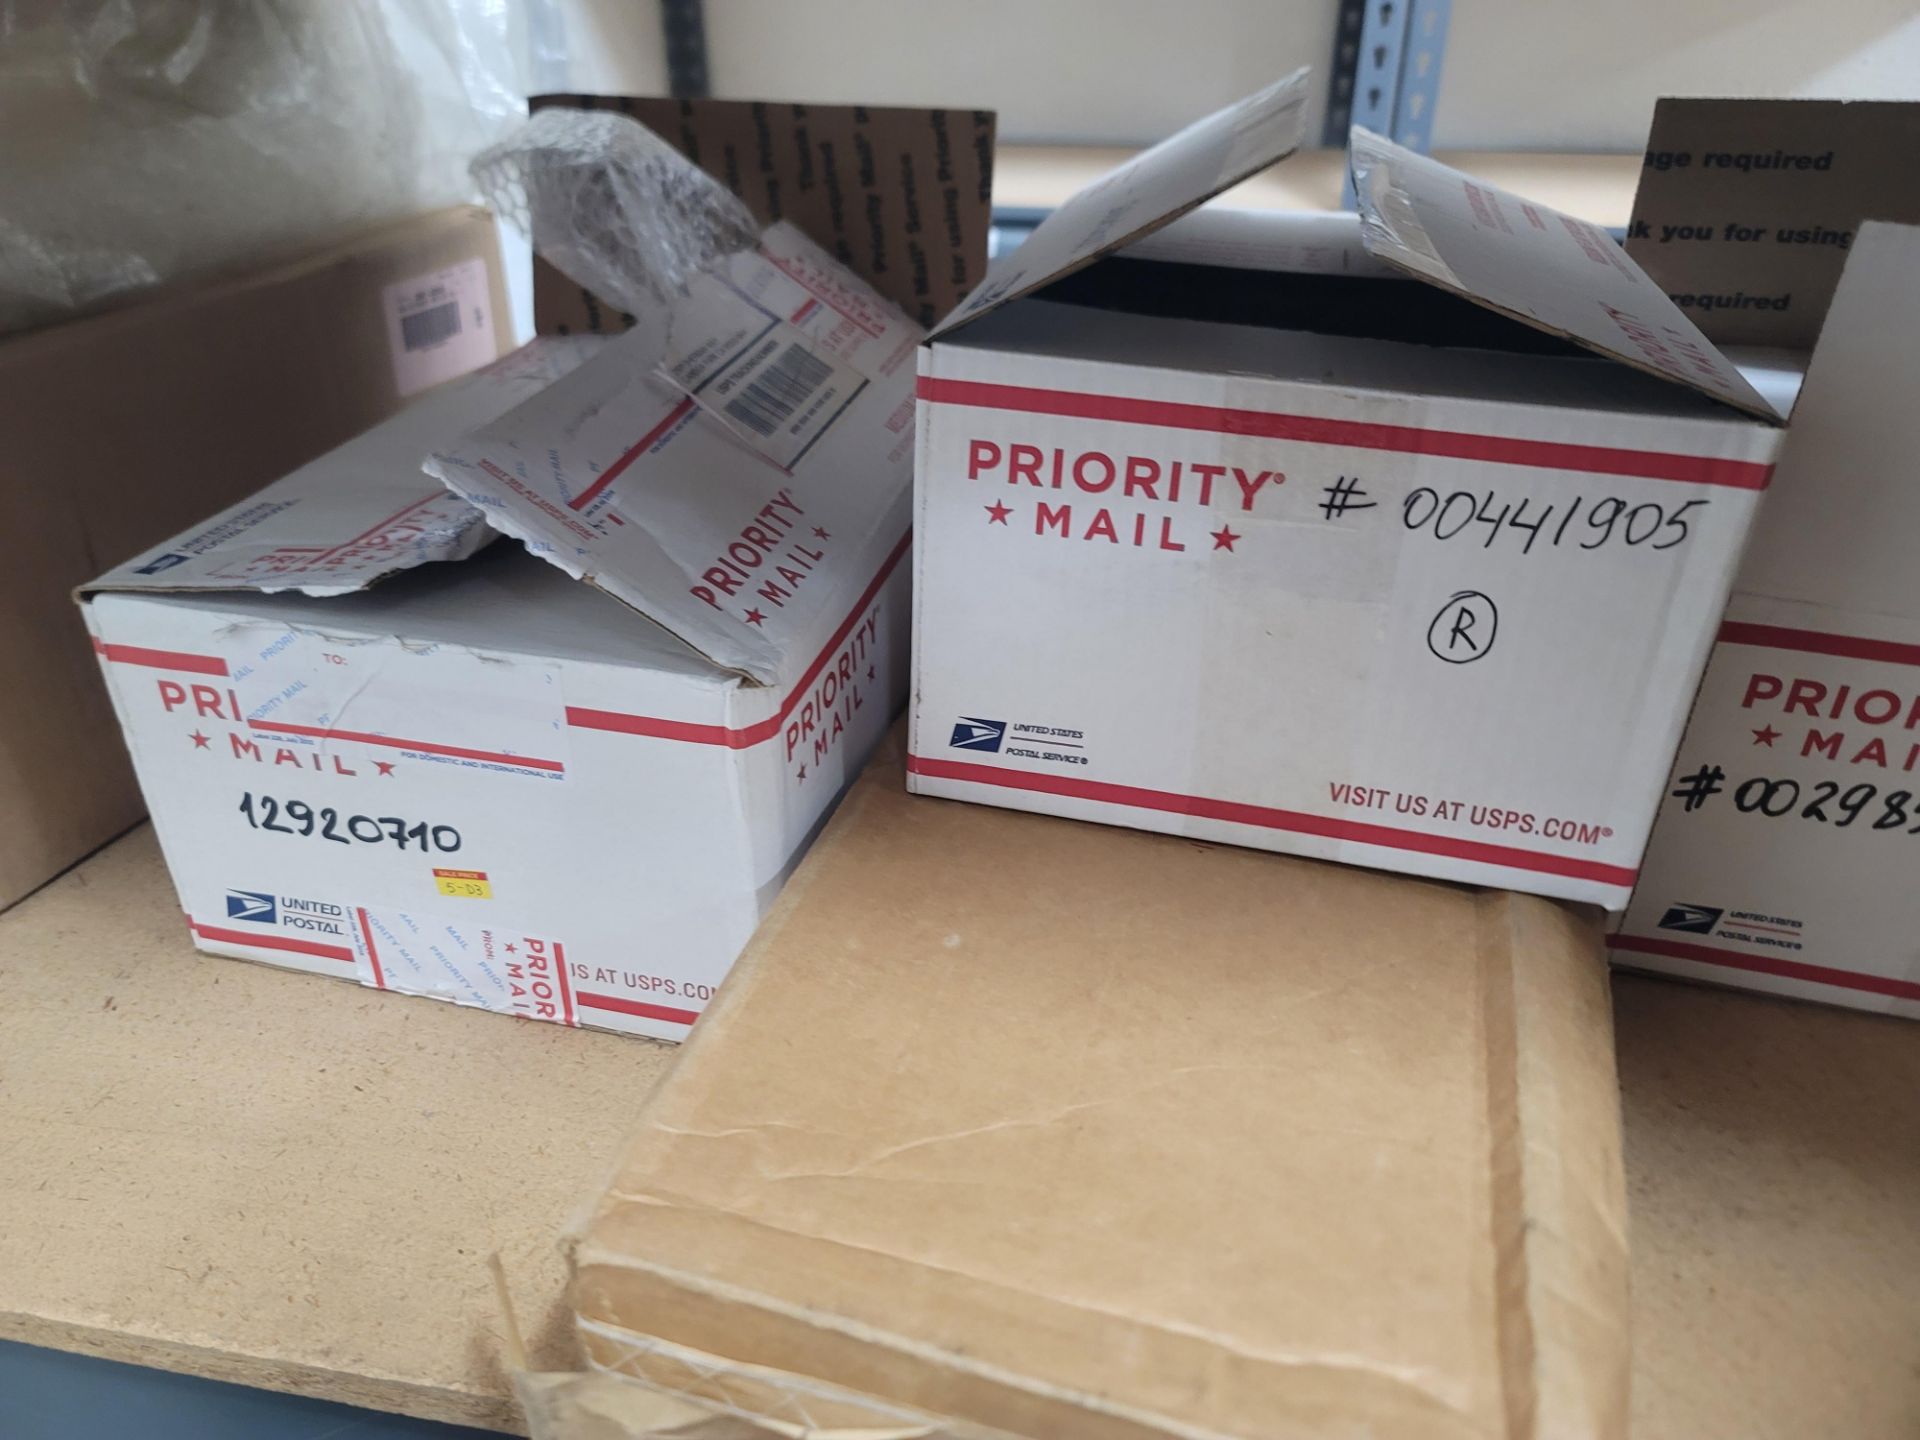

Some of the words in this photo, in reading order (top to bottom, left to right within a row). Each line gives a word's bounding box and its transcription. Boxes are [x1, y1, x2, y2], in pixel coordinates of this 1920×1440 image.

[930, 110, 953, 181] Priorit
[1704, 149, 1834, 173] required
[1660, 223, 1714, 243] you
[1724, 223, 1766, 242] for
[1776, 225, 1852, 249] using
[1035, 502, 1186, 552] MAIL
[1318, 475, 1377, 521] #
[1404, 486, 1711, 554] 00441905
[757, 544, 824, 608] MAIL
[259, 630, 298, 662] PRIORIT
[321, 652, 348, 666] TO:
[157, 680, 243, 722] PRI
[814, 684, 864, 767] MAIL
[1013, 723, 1050, 735] UNITED
[1050, 728, 1084, 739] STATES
[228, 732, 358, 777] MAIL
[401, 751, 418, 759] FOR
[419, 754, 460, 766] DOMESTIC
[461, 760, 479, 768] AND
[480, 763, 546, 778] INTERNATIONAL
[1006, 747, 1040, 759] POSTAL
[1330, 782, 1390, 809] VISIT
[1395, 793, 1428, 816] US
[1433, 800, 1465, 822] AT
[239, 791, 462, 852] 12920710
[281, 896, 342, 916] UNITED
[1730, 911, 1769, 923] UNITED
[283, 915, 345, 935] POSTAL
[446, 925, 469, 951] MAIL
[1715, 930, 1751, 943] POSTAL
[430, 944, 473, 990] PRIORITY
[523, 937, 556, 1020] PRIOR
[595, 968, 616, 984] AT
